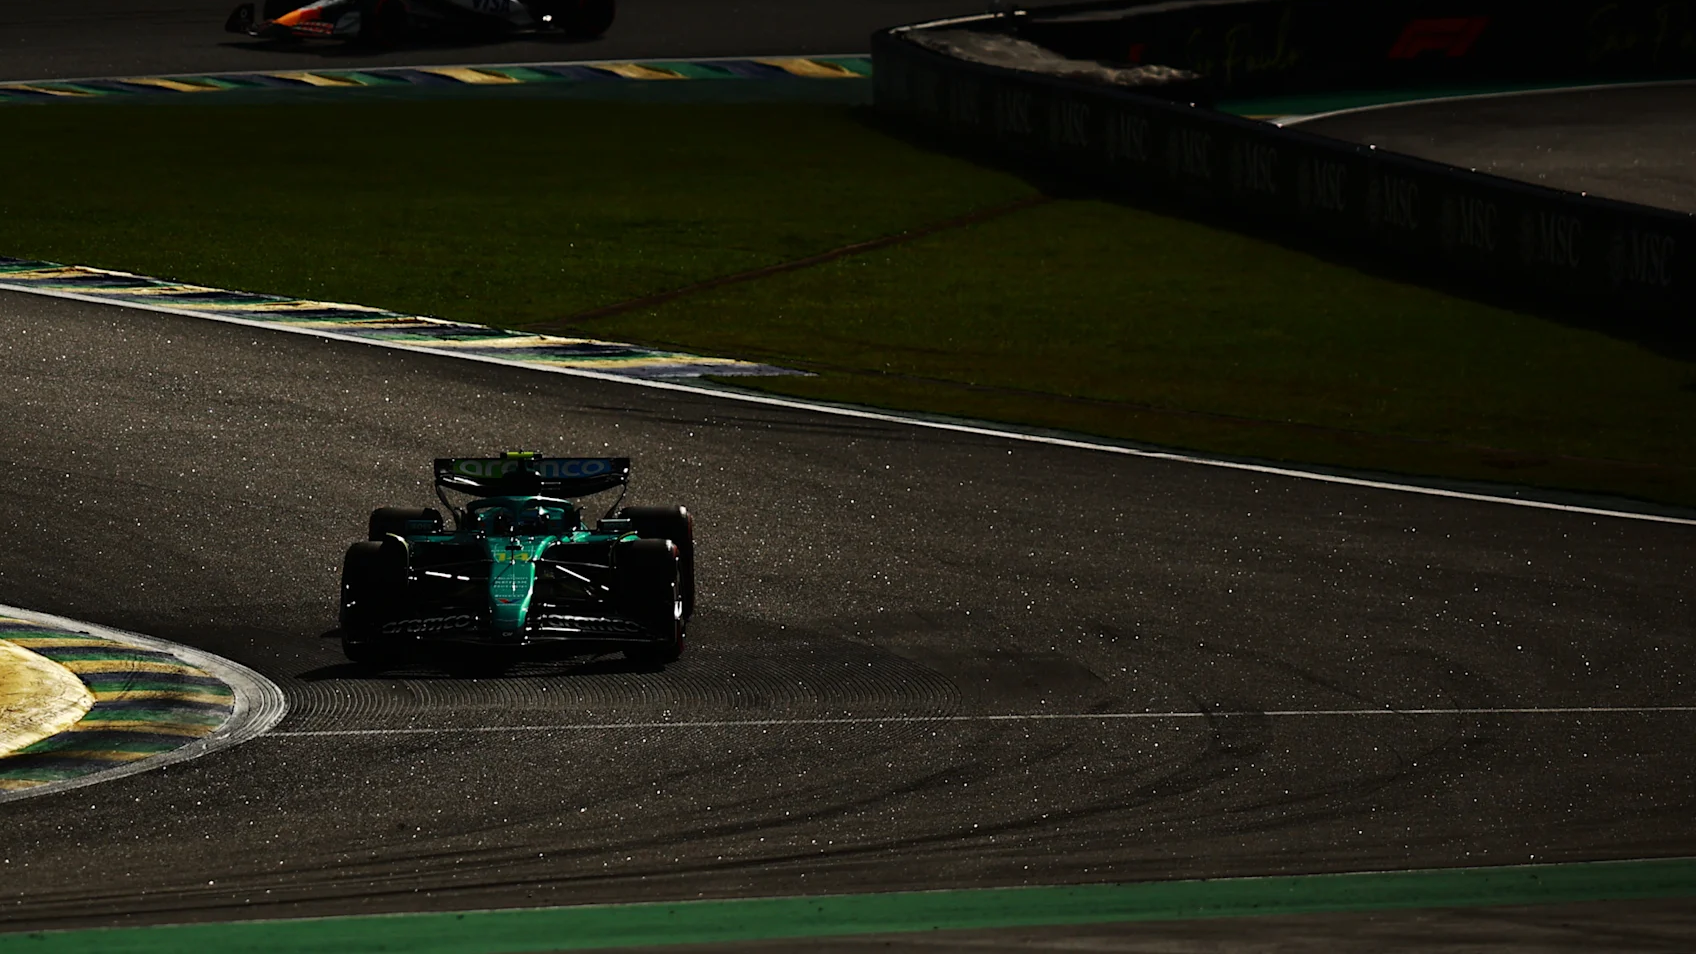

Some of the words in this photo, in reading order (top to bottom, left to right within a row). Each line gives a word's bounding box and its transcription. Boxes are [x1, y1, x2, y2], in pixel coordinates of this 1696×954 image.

[1313, 156, 1347, 212] MSC
[1384, 172, 1419, 231] MSC
[1459, 195, 1498, 252] MSC
[1539, 211, 1582, 268] MSC
[1629, 228, 1676, 287] MSC
